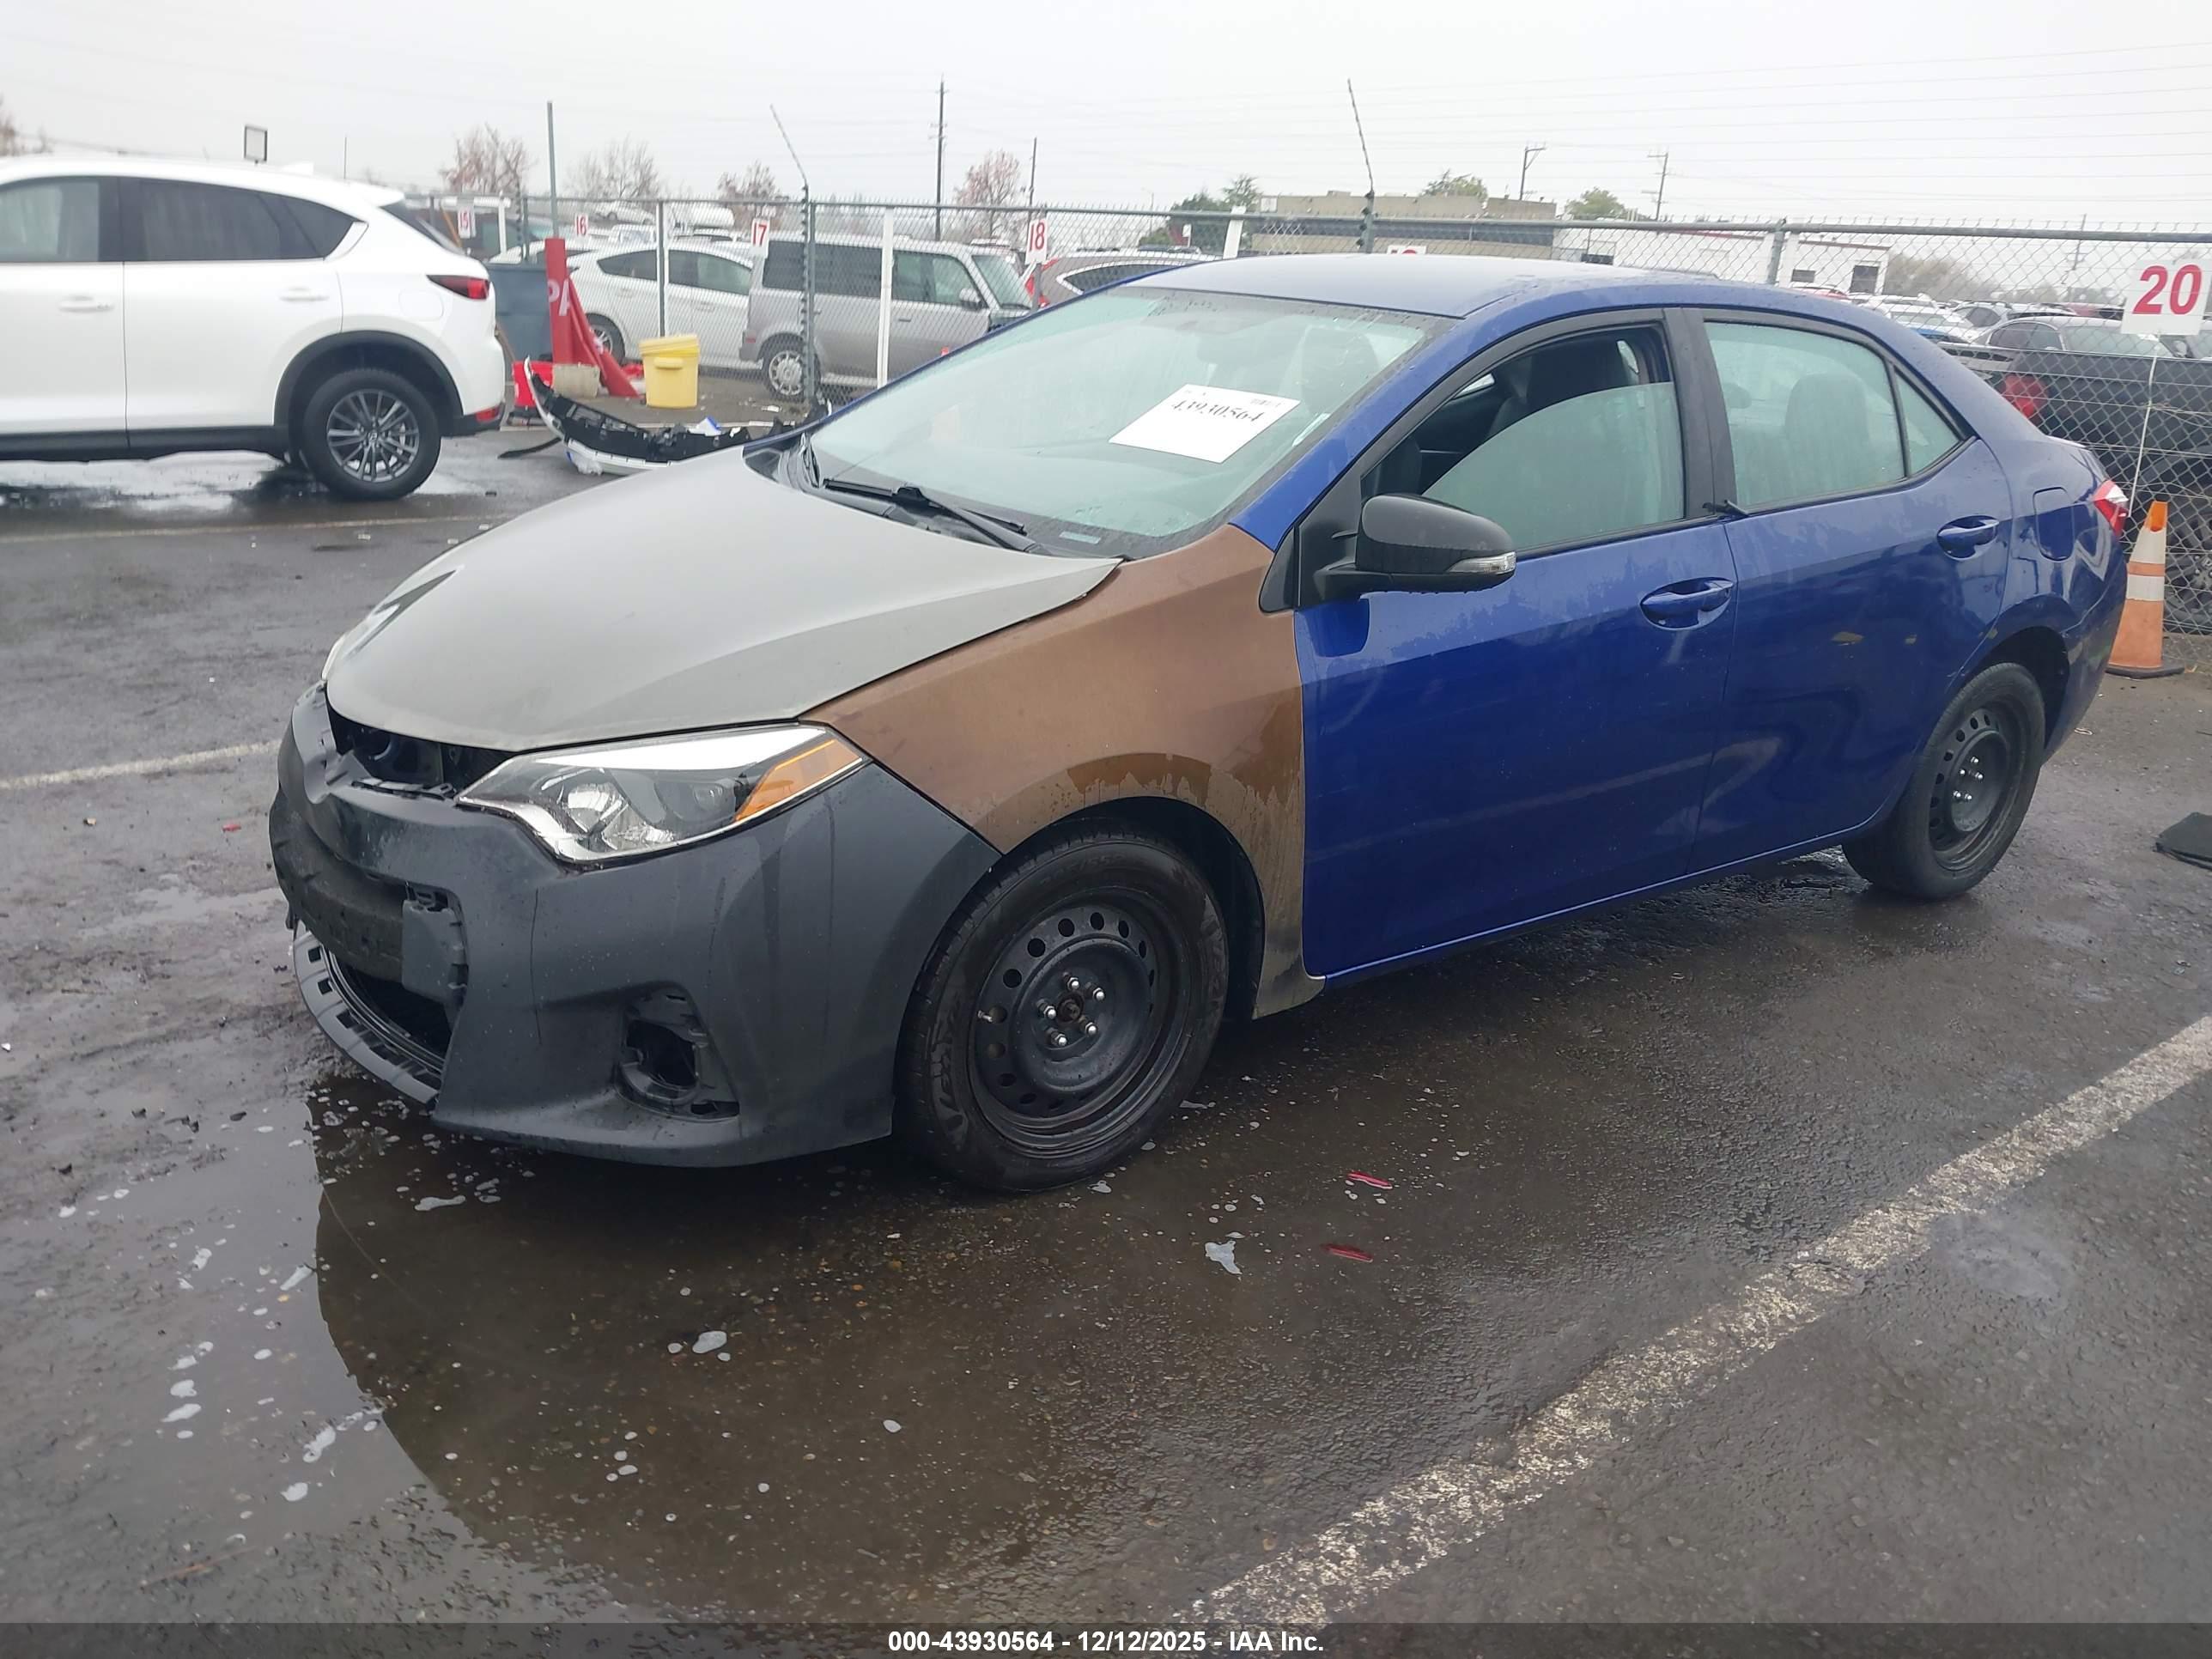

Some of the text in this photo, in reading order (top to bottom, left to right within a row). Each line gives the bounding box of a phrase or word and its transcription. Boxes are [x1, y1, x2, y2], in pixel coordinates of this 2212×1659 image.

[576, 216, 587, 236] 16
[753, 222, 768, 246] 17
[1030, 222, 1045, 252] 18
[2132, 264, 2203, 315] 20
[1171, 399, 1265, 422] 43930564
